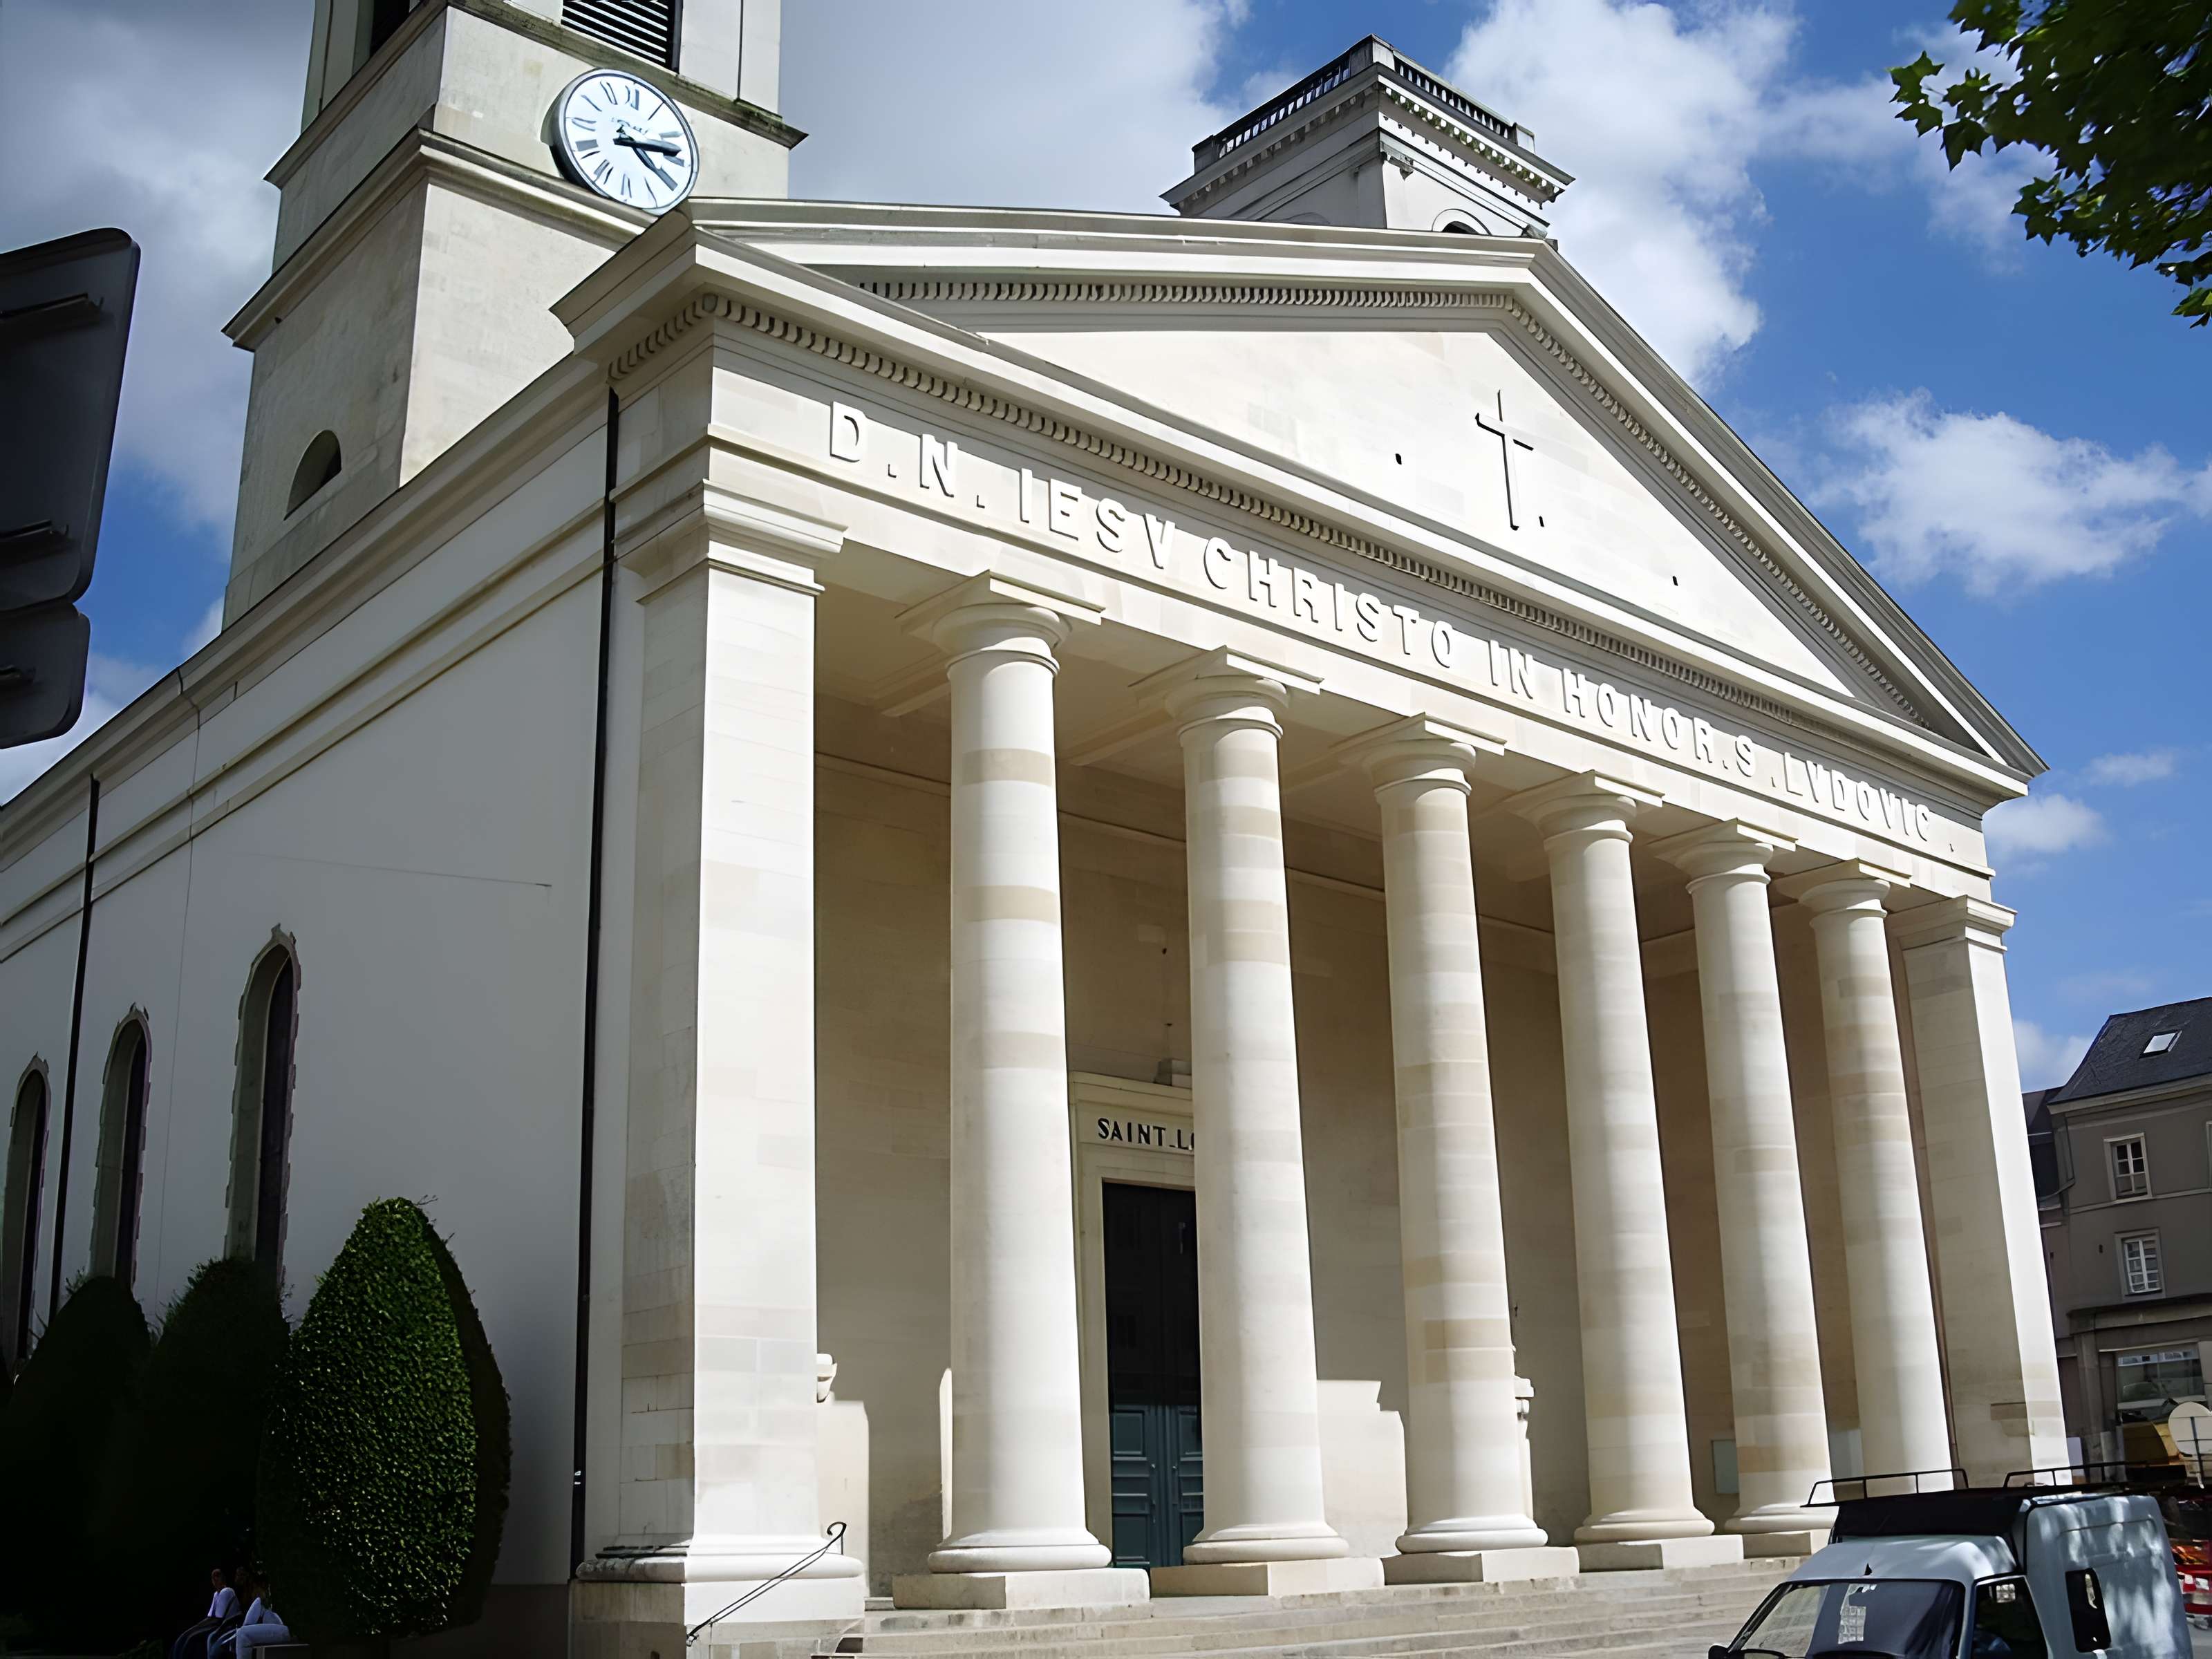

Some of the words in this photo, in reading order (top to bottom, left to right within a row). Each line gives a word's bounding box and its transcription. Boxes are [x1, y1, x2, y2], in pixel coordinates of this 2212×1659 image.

[1018, 467, 1176, 570] IESV
[1203, 536, 1454, 668] CHRISTO
[1489, 639, 1534, 700] IN
[1097, 1117, 1166, 1147] SAINT
